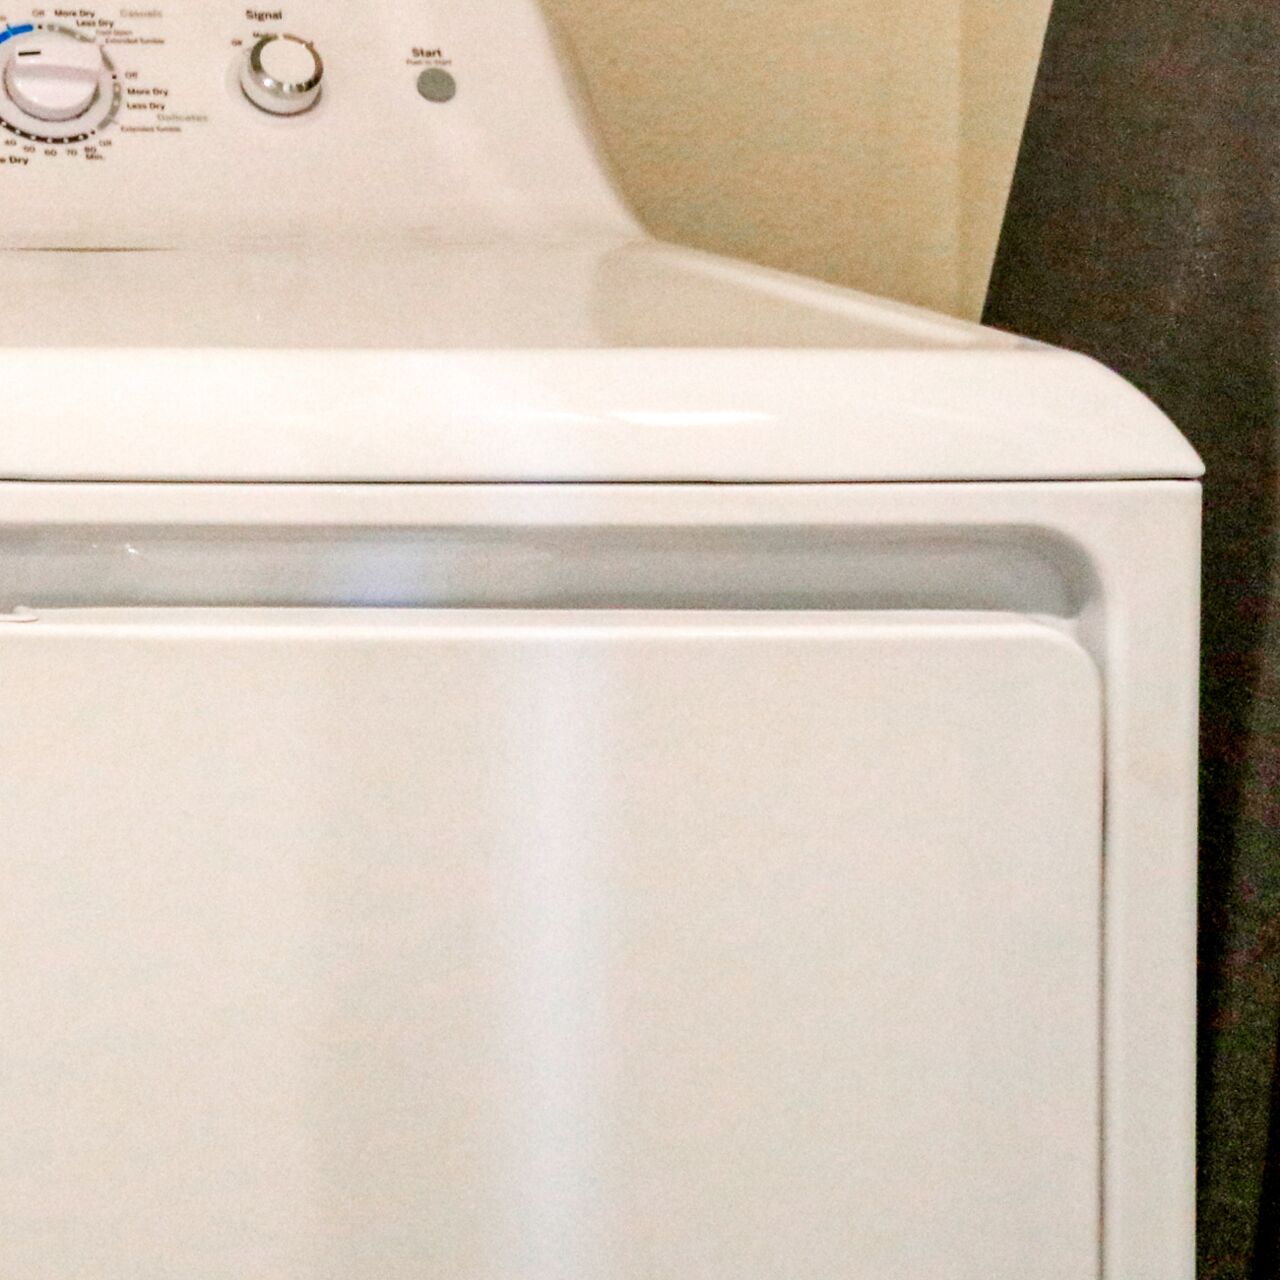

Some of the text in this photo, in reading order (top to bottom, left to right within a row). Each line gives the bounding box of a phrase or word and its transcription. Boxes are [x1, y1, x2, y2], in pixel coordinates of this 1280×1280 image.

[54, 9, 95, 18] More Dry
[245, 9, 282, 21] Signal
[98, 20, 114, 28] Dry
[412, 47, 442, 57] Start
[152, 88, 168, 96] Dry
[9, 155, 29, 165] Dry
